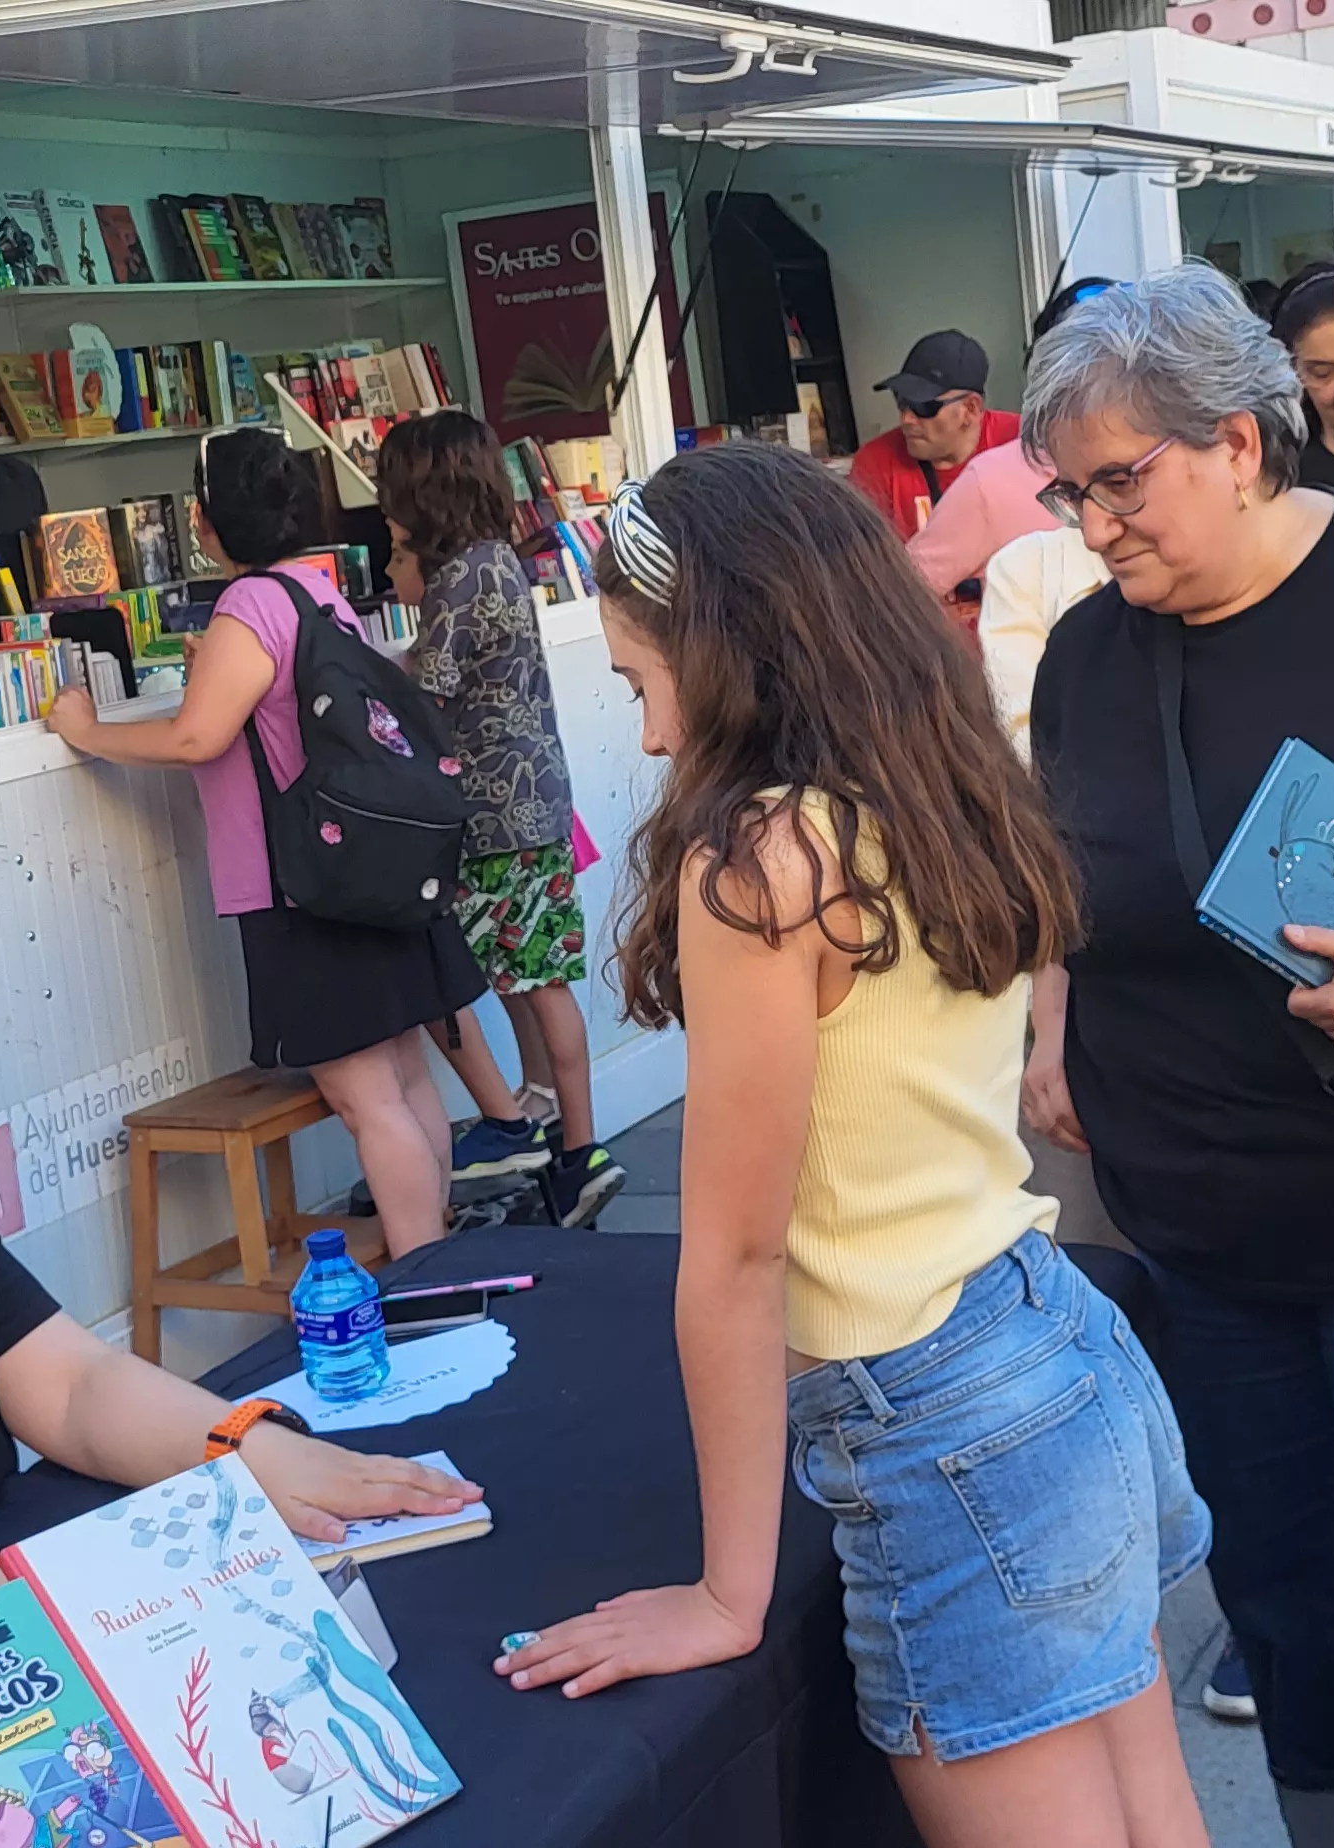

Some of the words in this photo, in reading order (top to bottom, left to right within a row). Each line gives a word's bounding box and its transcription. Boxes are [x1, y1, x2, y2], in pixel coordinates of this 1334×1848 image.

[474, 242, 562, 280] SANTOS
[23, 1058, 186, 1150] Ayuntamiento
[30, 1157, 61, 1194] de
[66, 1129, 130, 1179] Hues
[92, 1596, 175, 1638] Ruidos
[181, 1585, 203, 1611] y
[201, 1546, 283, 1588] ruiditos
